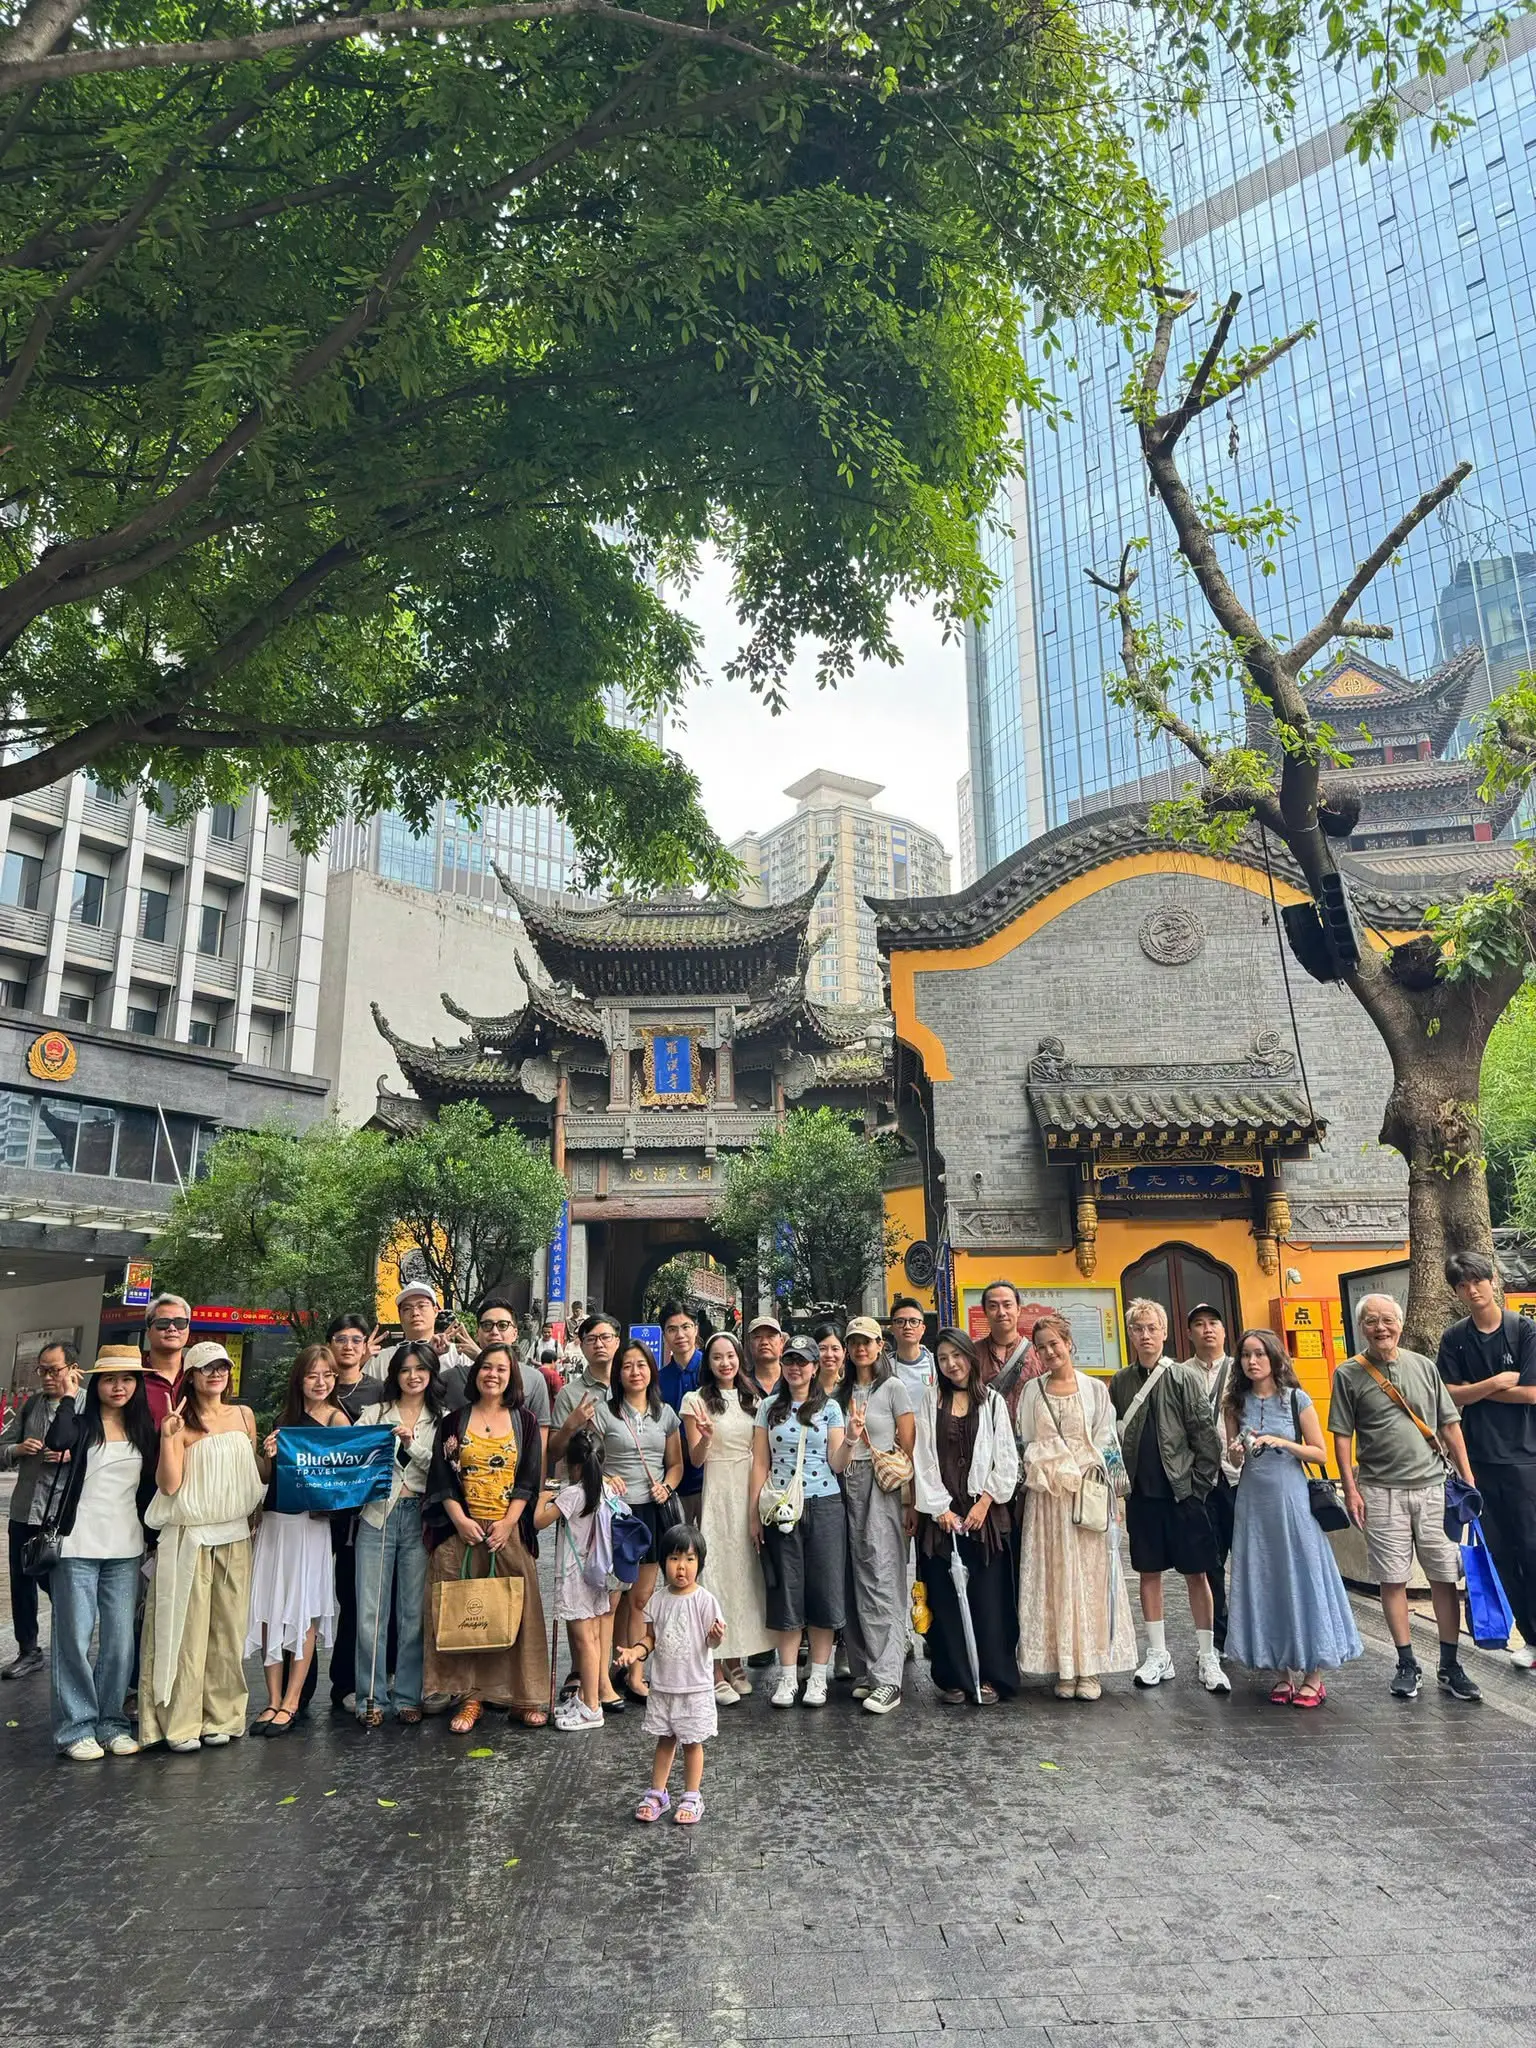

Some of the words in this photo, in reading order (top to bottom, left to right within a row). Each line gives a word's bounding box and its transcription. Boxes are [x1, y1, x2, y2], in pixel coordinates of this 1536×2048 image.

[1294, 1307, 1311, 1325] 点
[296, 1452, 363, 1466] BlueWay
[296, 1468, 337, 1476] TRAVEL
